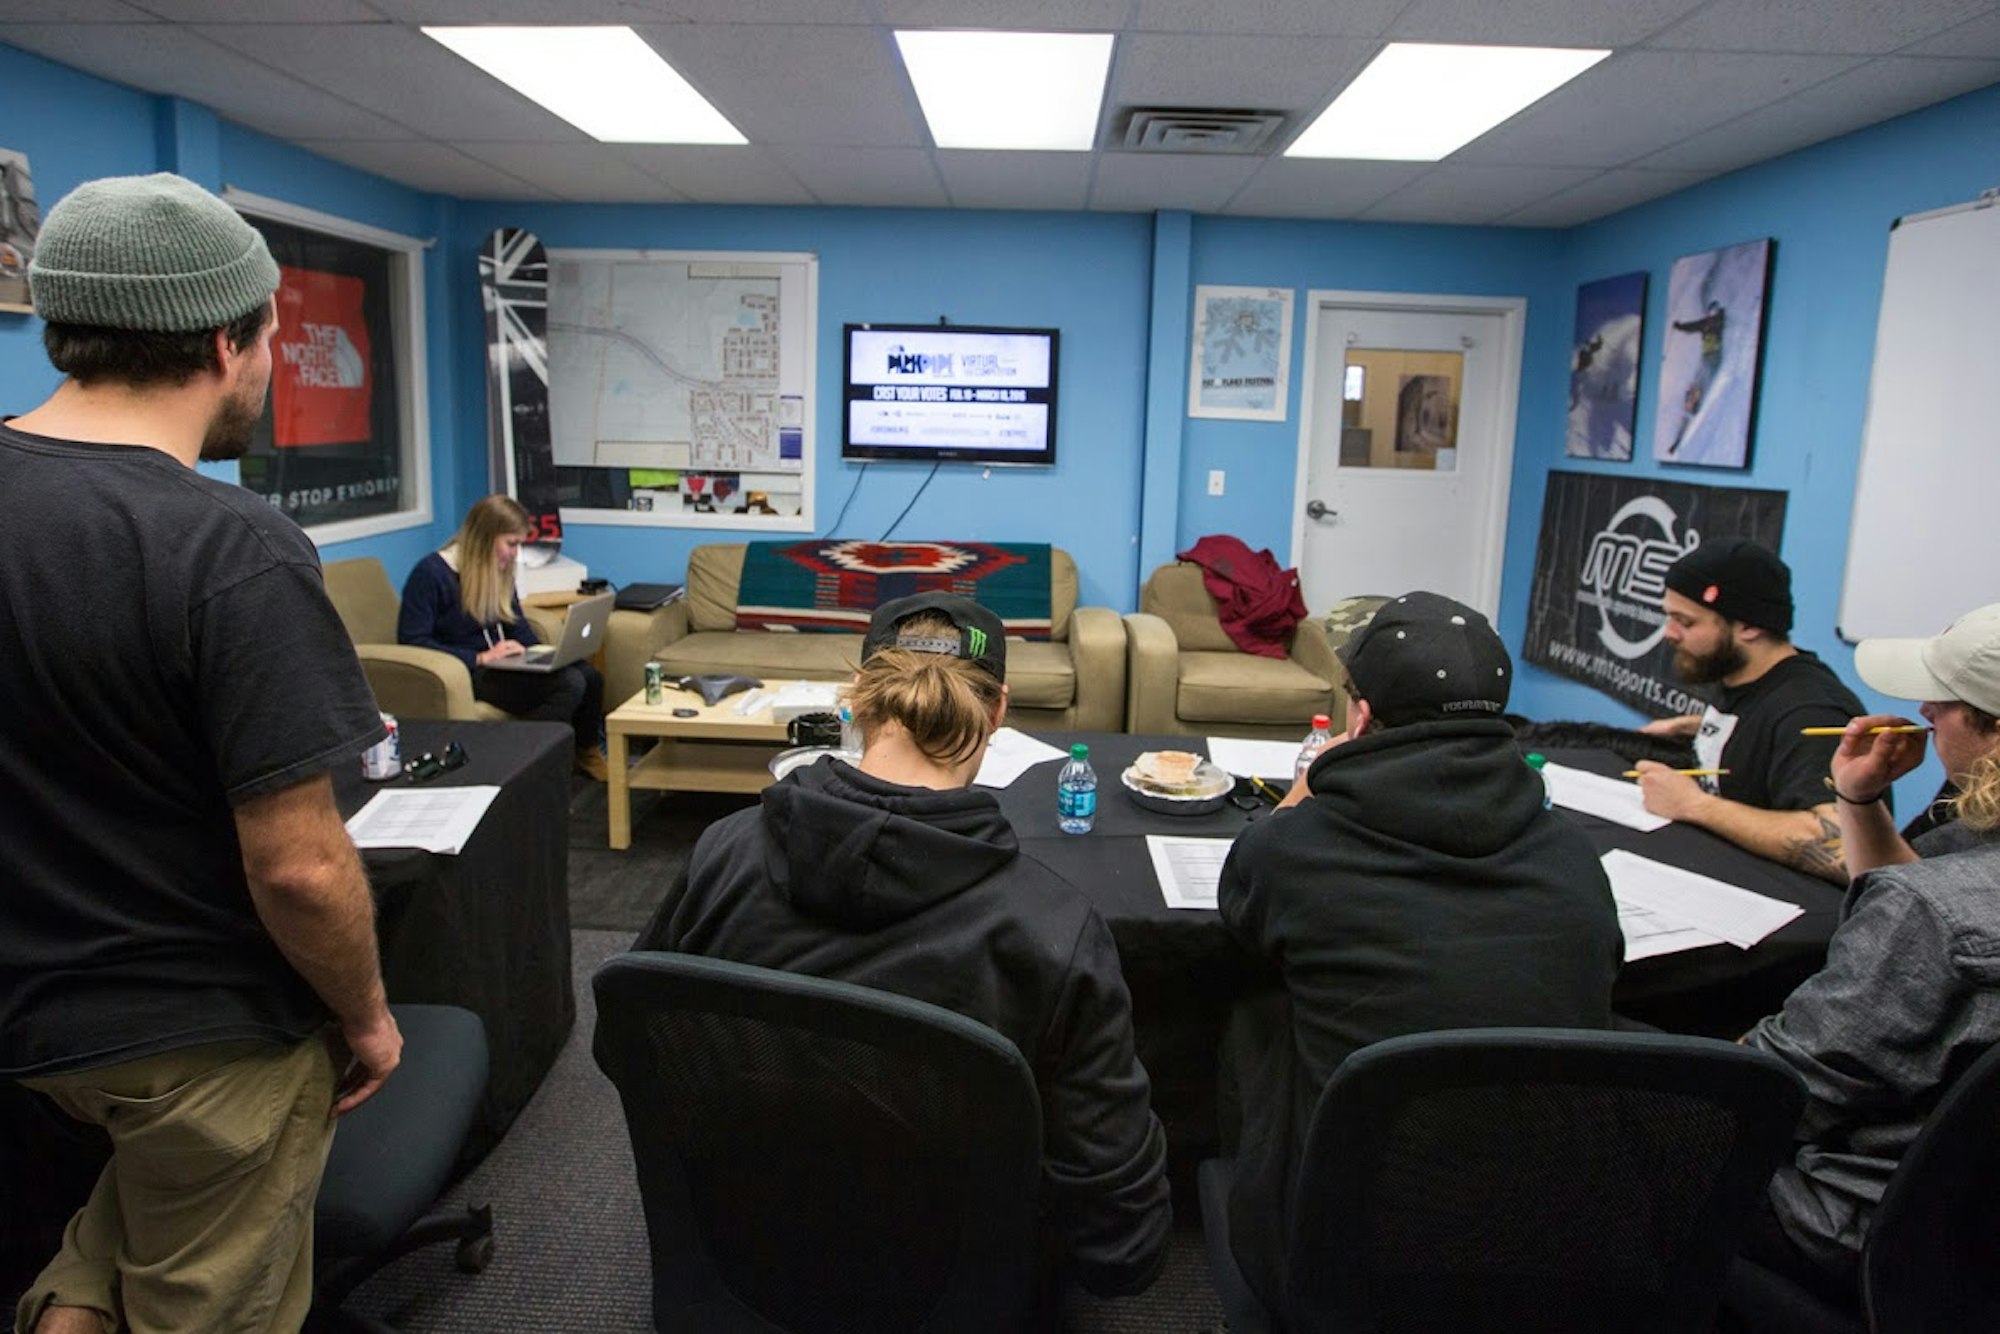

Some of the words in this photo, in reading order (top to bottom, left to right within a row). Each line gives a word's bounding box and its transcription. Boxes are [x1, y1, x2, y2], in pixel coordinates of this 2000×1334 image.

[301, 323, 337, 346] THE
[281, 342, 337, 367] NORTH
[300, 365, 339, 388] FACE
[874, 386, 895, 400] CAST
[896, 386, 920, 400] YOUR
[920, 387, 947, 401] VOTES
[289, 487, 333, 508] STOP
[1549, 639, 1706, 717] www.mtsports.com
